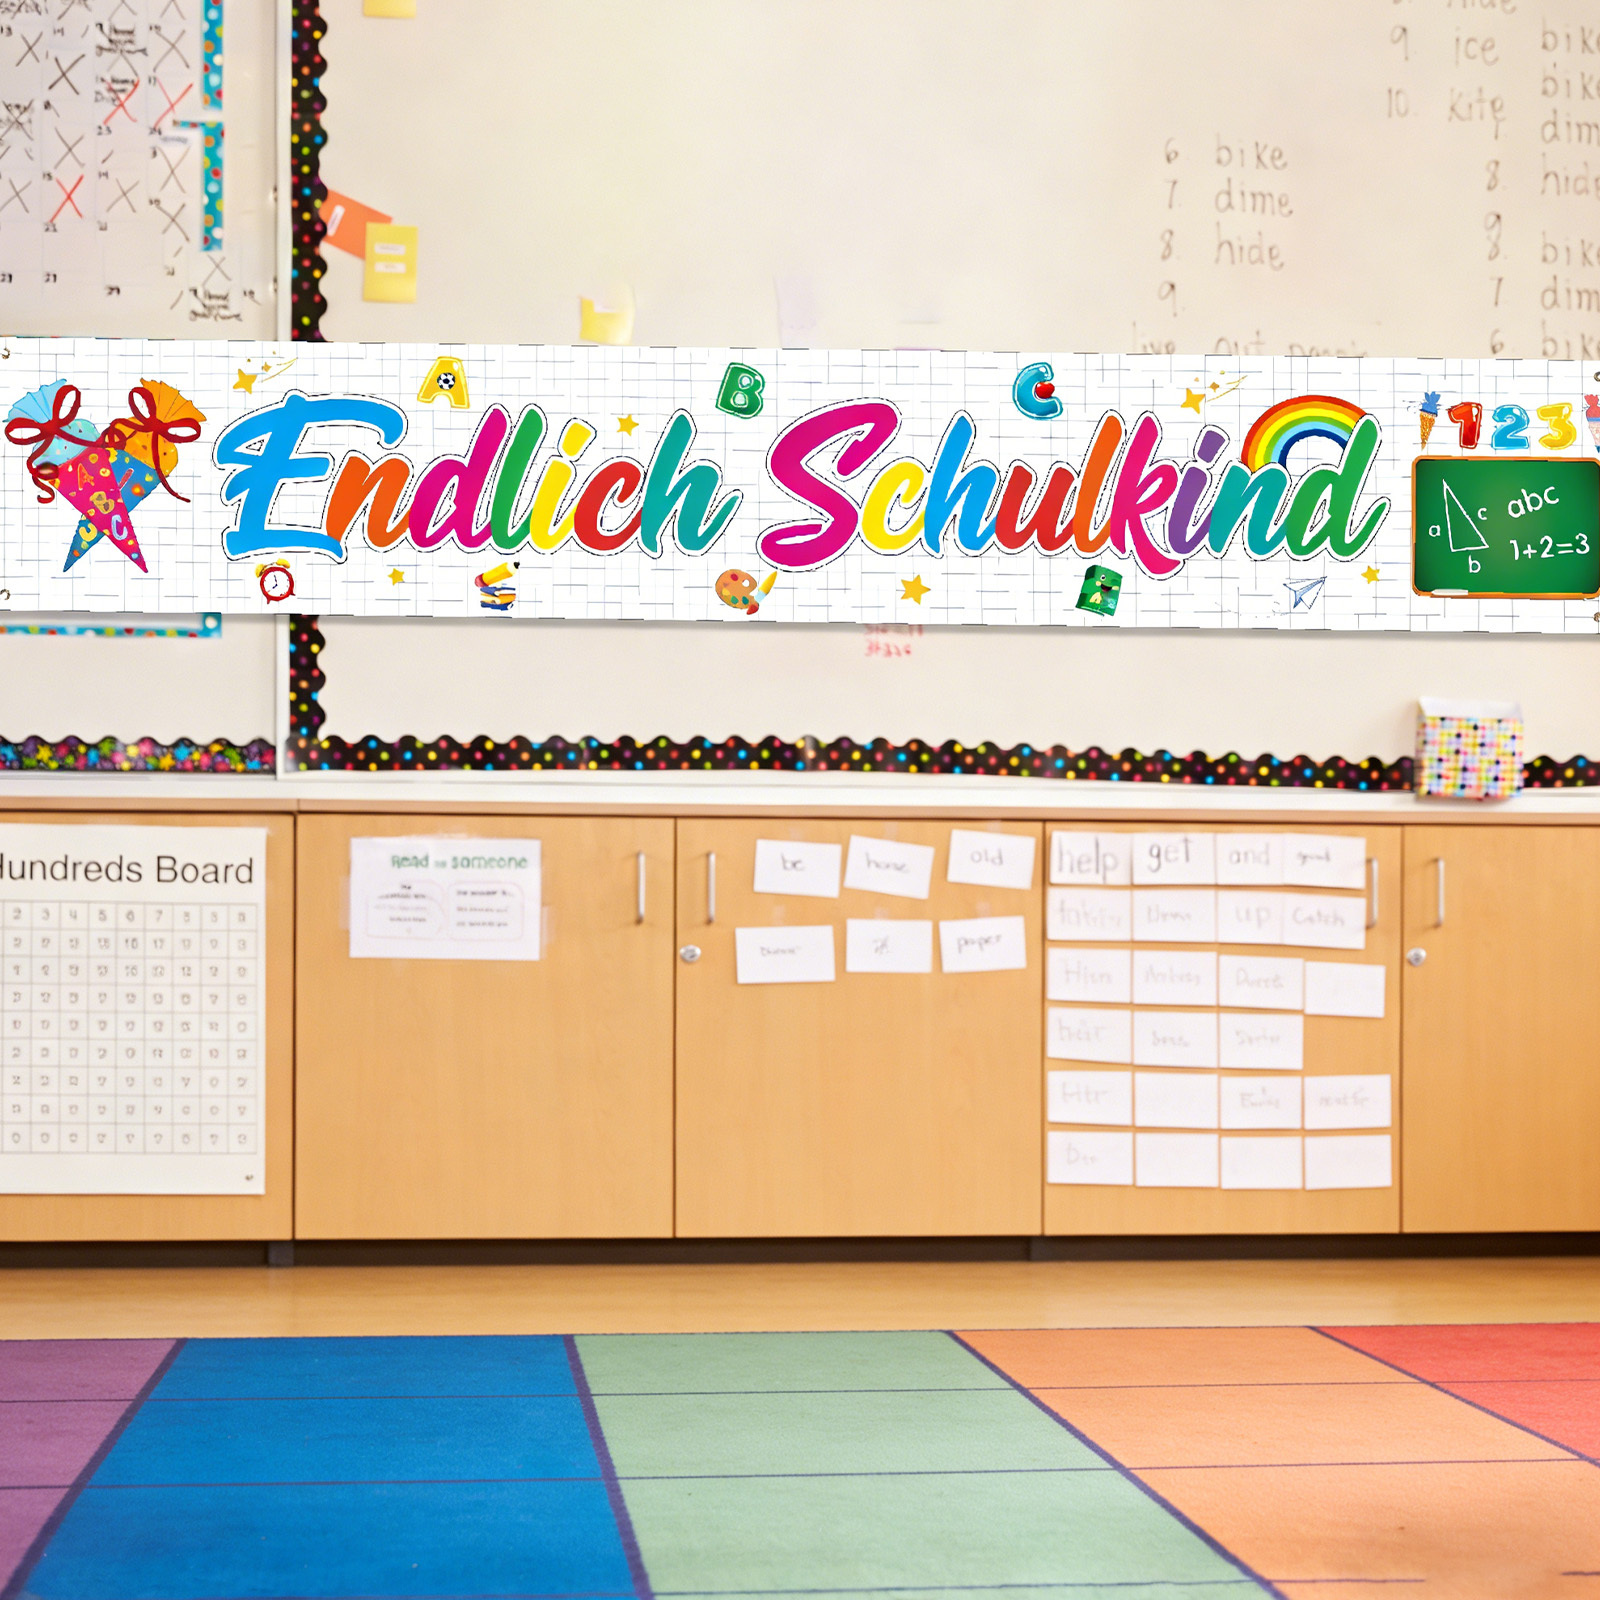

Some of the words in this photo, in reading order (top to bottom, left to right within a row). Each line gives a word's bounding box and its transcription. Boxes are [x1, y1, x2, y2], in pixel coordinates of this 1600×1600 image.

[1454, 26, 1500, 66] ice
[1541, 16, 1600, 54] bik
[1541, 66, 1600, 100] bik
[1448, 86, 1506, 122] kite
[1215, 132, 1289, 171] bike
[1214, 177, 1294, 217] dime
[1214, 221, 1285, 271] hide
[1541, 230, 1600, 267] bik
[1541, 318, 1600, 358] bik
[417, 356, 471, 410] A
[715, 362, 766, 420] B
[1012, 362, 1064, 420] C
[213, 390, 743, 562] Endlich
[757, 398, 1391, 579] Schulkind
[1507, 485, 1561, 520] abc
[1427, 524, 1442, 538] a
[1508, 532, 1591, 561] 1+2=3
[1467, 557, 1482, 575] b
[0, 853, 143, 884] undreds
[156, 854, 254, 884] Board
[1057, 836, 1119, 884] help
[1147, 837, 1191, 873] get
[1228, 843, 1271, 867] and
